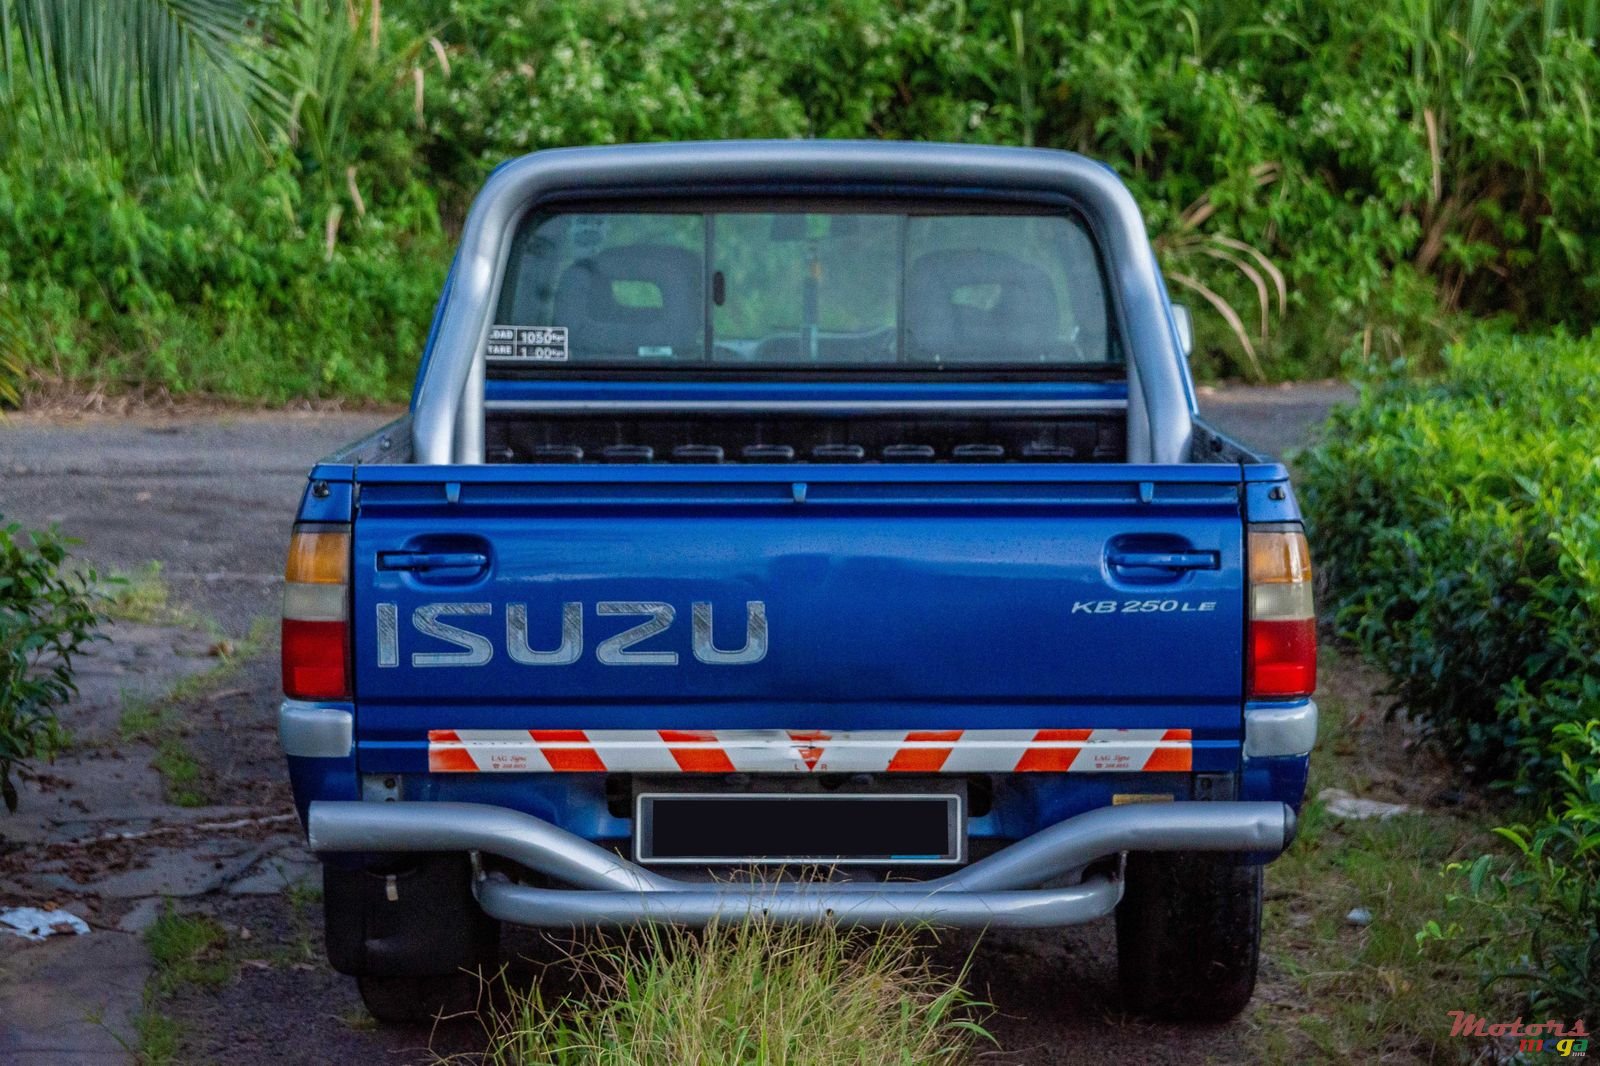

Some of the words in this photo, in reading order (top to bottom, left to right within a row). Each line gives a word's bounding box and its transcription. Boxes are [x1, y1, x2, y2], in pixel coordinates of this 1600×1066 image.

[1071, 600, 1118, 614] KB
[1121, 599, 1179, 613] 250
[1181, 601, 1217, 612] LE
[376, 601, 768, 668] ISUZU
